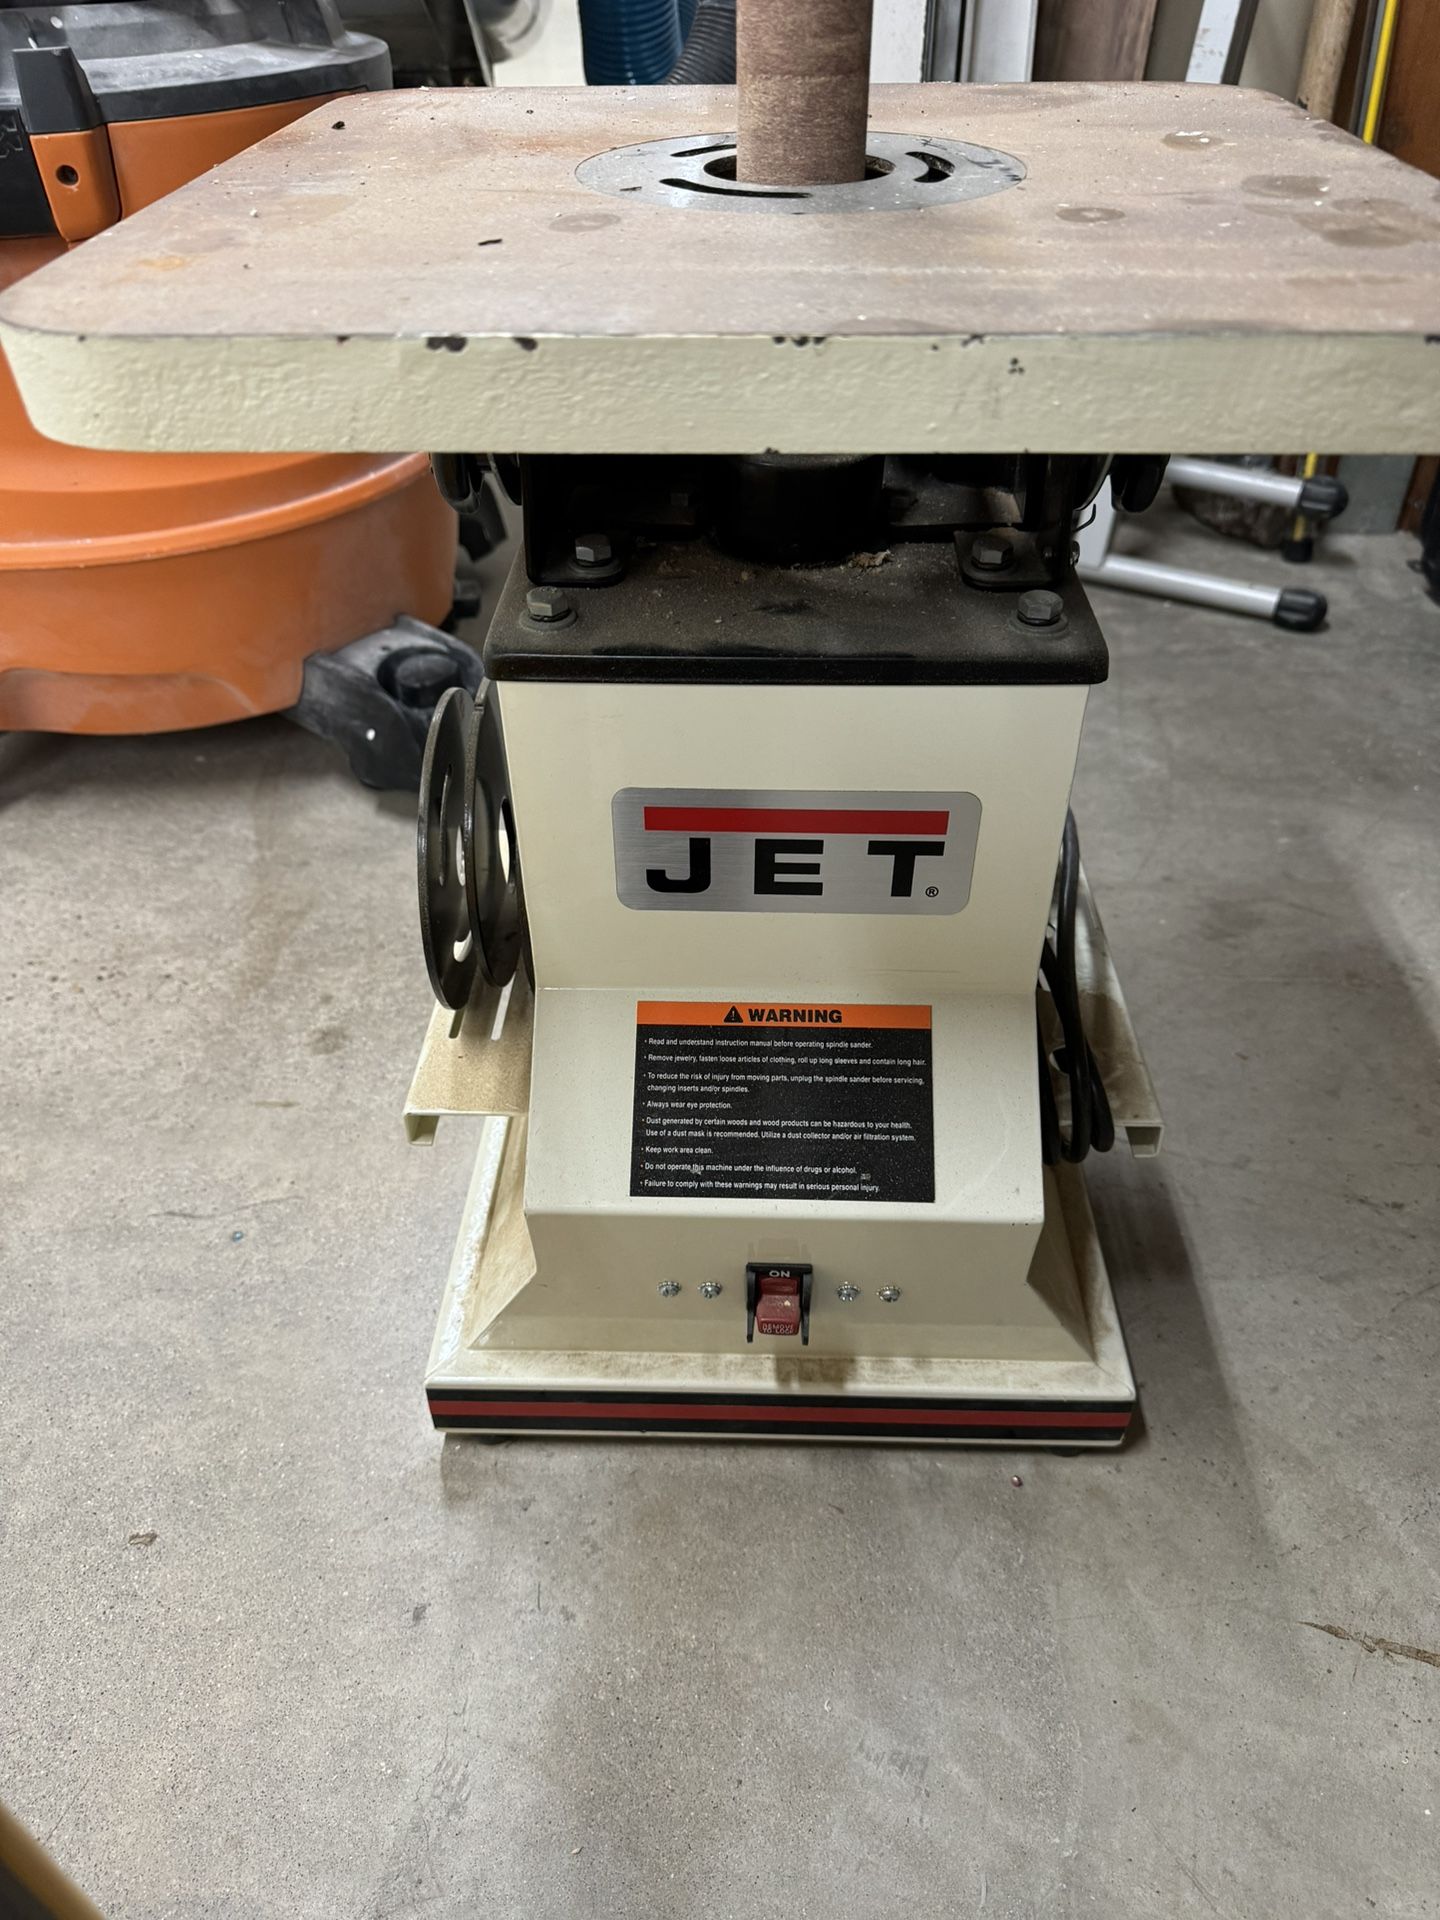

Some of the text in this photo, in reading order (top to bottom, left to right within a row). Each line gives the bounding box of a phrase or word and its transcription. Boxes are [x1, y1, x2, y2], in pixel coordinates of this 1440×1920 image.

[646, 837, 946, 898] JET
[748, 1008, 843, 1023] WARNING
[666, 1038, 678, 1046] and
[679, 1038, 714, 1046] understand
[714, 1038, 749, 1046] instruction
[750, 1039, 772, 1047] manual
[794, 1040, 824, 1050] operating
[826, 1040, 848, 1050] spindle
[850, 1040, 873, 1048] sander.
[648, 1054, 674, 1062] Remove
[674, 1054, 698, 1064] jewelry,
[720, 1054, 736, 1062] loose
[738, 1055, 760, 1063] articles
[770, 1056, 797, 1066] clothing,
[808, 1057, 818, 1066] up
[818, 1056, 833, 1066] long
[834, 1056, 858, 1064] sleeves
[872, 1057, 896, 1065] contain
[896, 1058, 912, 1068] long
[912, 1058, 927, 1066] hair.
[648, 1072, 656, 1080] To
[679, 1072, 690, 1080] the
[712, 1072, 730, 1082] injury
[730, 1073, 746, 1081] from
[746, 1074, 770, 1083] moving
[771, 1074, 790, 1084] parts,
[790, 1074, 812, 1084] unplug
[825, 1074, 848, 1084] spindle
[849, 1075, 871, 1083] sander
[872, 1076, 892, 1084] before
[894, 1076, 925, 1086] servicing,
[646, 1084, 676, 1094] changing
[722, 1085, 750, 1094] spindles.
[646, 1100, 669, 1110] Always
[686, 1102, 698, 1110] eye
[699, 1101, 732, 1111] protection.
[662, 1117, 694, 1127] generated
[694, 1118, 702, 1127] by
[726, 1118, 748, 1126] woods
[780, 1119, 809, 1129] products
[822, 1120, 832, 1128] be
[874, 1122, 890, 1130] your
[646, 1129, 658, 1137] Use
[802, 1132, 830, 1140] collector
[832, 1132, 852, 1140] and/or
[862, 1132, 890, 1140] filtration
[891, 1133, 916, 1143] system.
[645, 1146, 662, 1155] Keep
[694, 1146, 714, 1154] clean.
[644, 1162, 654, 1170] Do
[667, 1162, 691, 1172] operate
[754, 1164, 764, 1172] the
[766, 1164, 794, 1172] influence
[804, 1165, 822, 1175] drugs
[832, 1166, 858, 1174] alcohol.
[644, 1180, 666, 1188] Failure
[675, 1180, 698, 1190] comply
[700, 1180, 714, 1188] with
[714, 1180, 732, 1188] these
[733, 1181, 763, 1191] warnings
[764, 1182, 777, 1192] may
[798, 1182, 805, 1190] in
[806, 1182, 830, 1190] serious
[831, 1182, 860, 1192] personal
[860, 1183, 880, 1193] injury.
